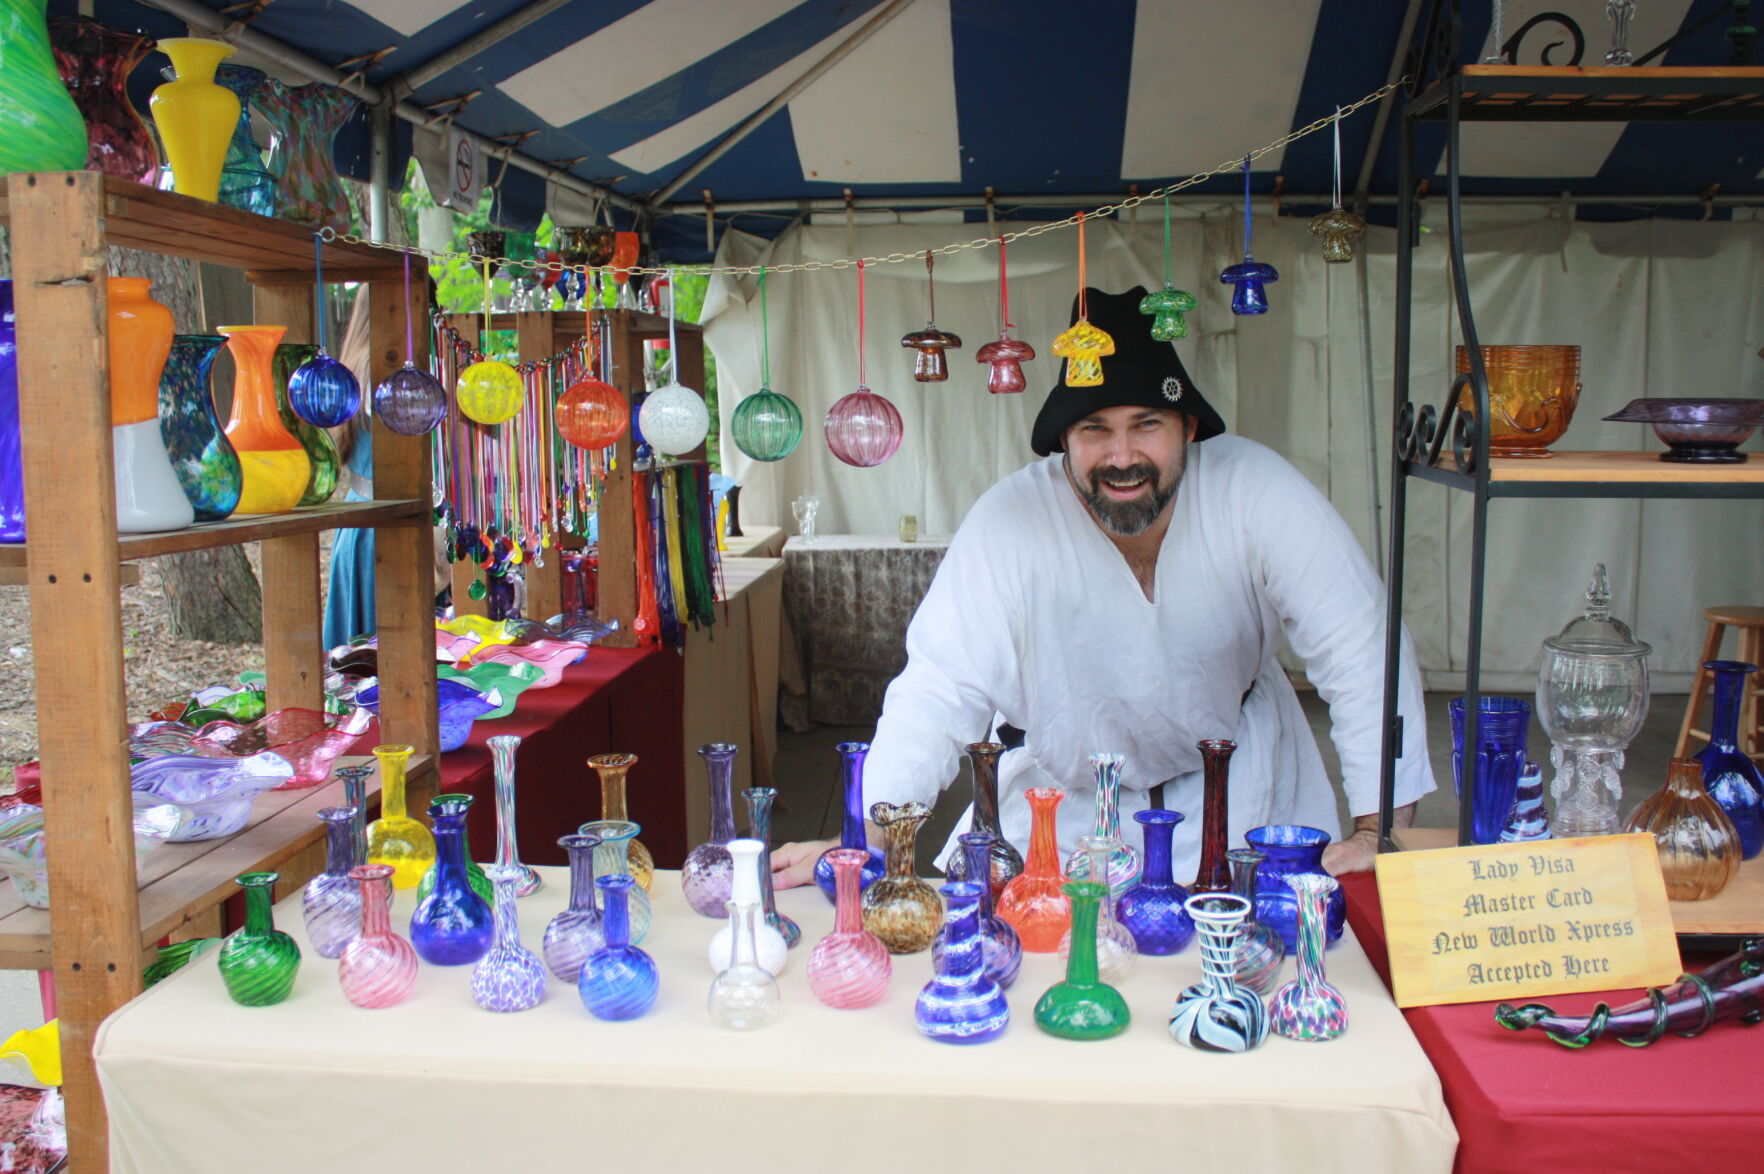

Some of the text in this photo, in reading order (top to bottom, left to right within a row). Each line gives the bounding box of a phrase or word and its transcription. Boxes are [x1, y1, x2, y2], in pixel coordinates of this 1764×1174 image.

[1468, 855, 1575, 881] Lady Visa
[1463, 887, 1593, 917] Master Card
[1431, 920, 1634, 955] New World Xpress
[1467, 955, 1609, 985] Accepted Here
